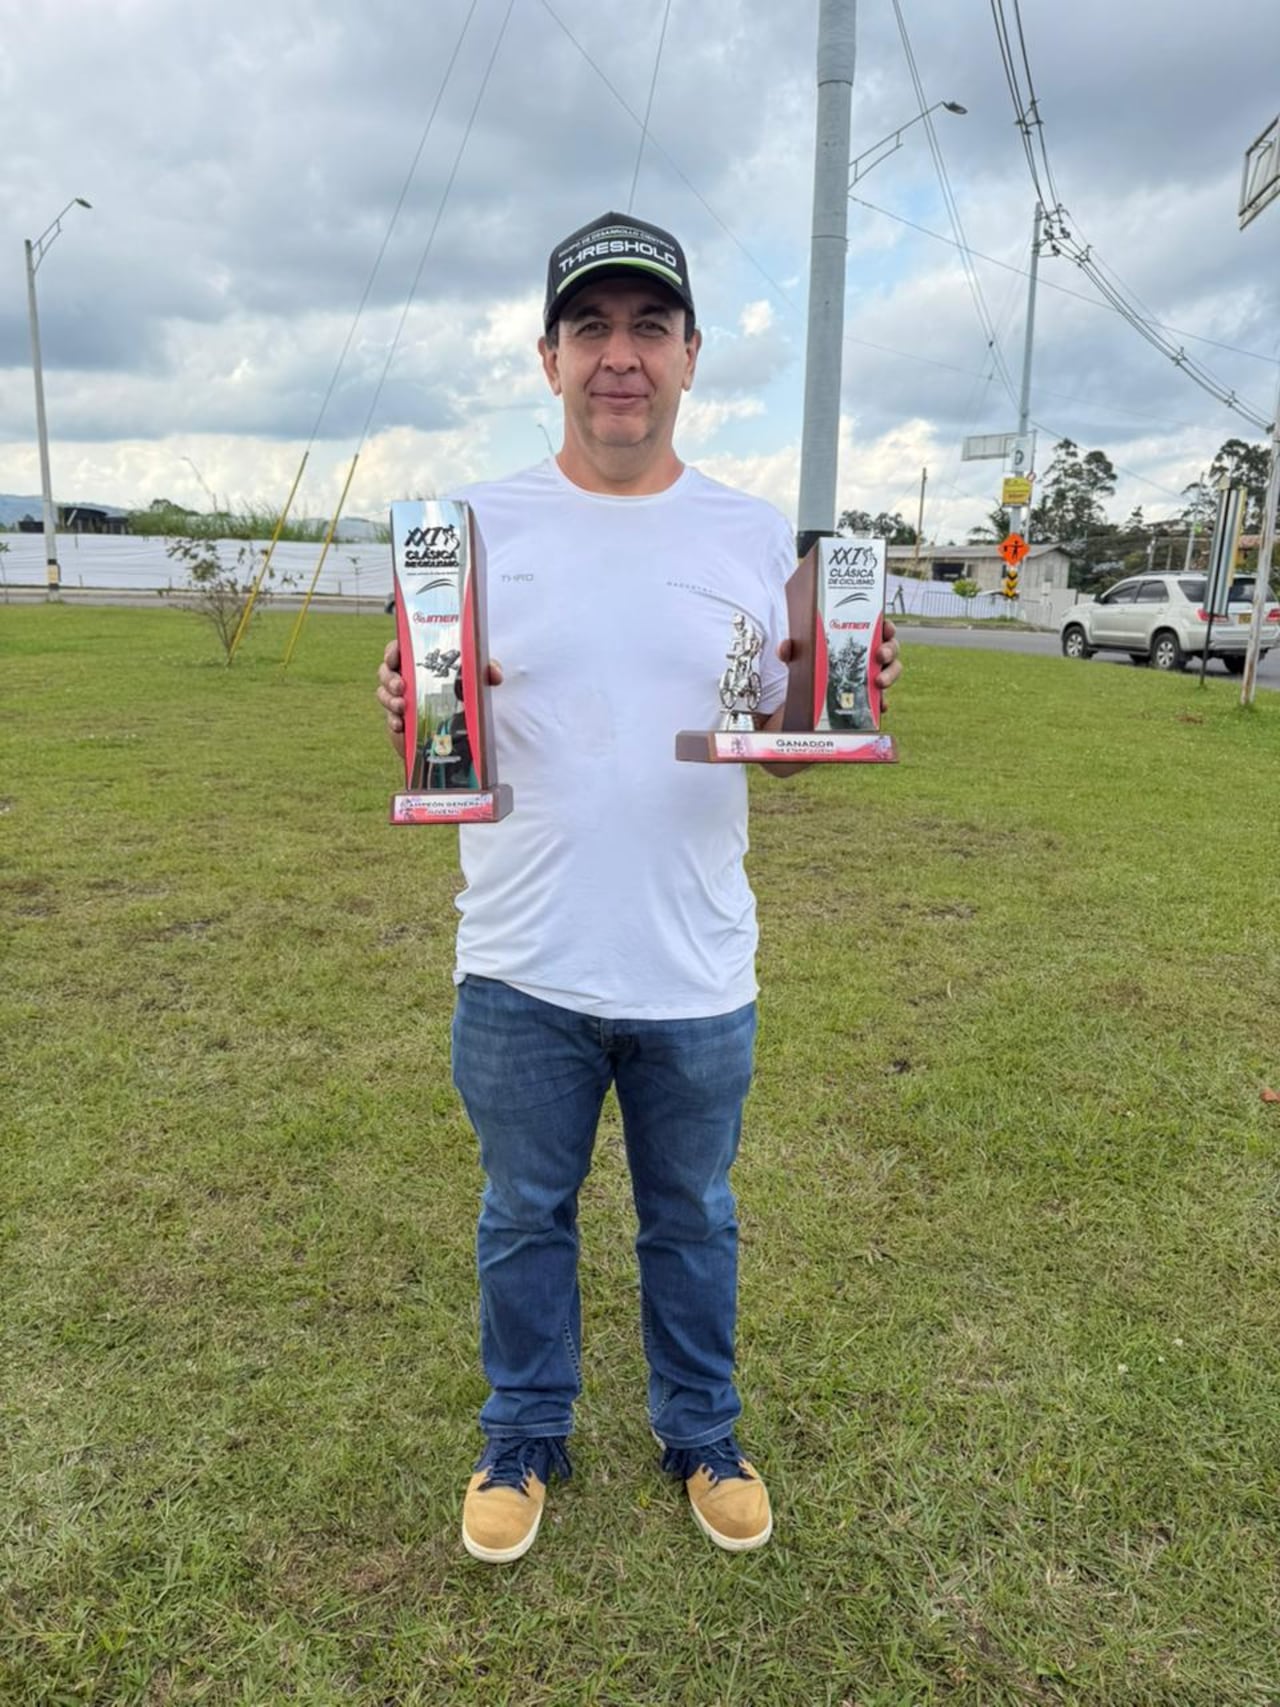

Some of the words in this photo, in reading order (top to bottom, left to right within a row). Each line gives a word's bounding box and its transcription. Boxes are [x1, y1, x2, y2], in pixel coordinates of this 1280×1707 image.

[559, 241, 677, 272] THRESHOLD
[405, 547, 457, 560] CLÁSICA
[828, 547, 864, 566] XXI
[830, 565, 874, 578] CLÁSICA
[776, 738, 834, 748] GANADOR
